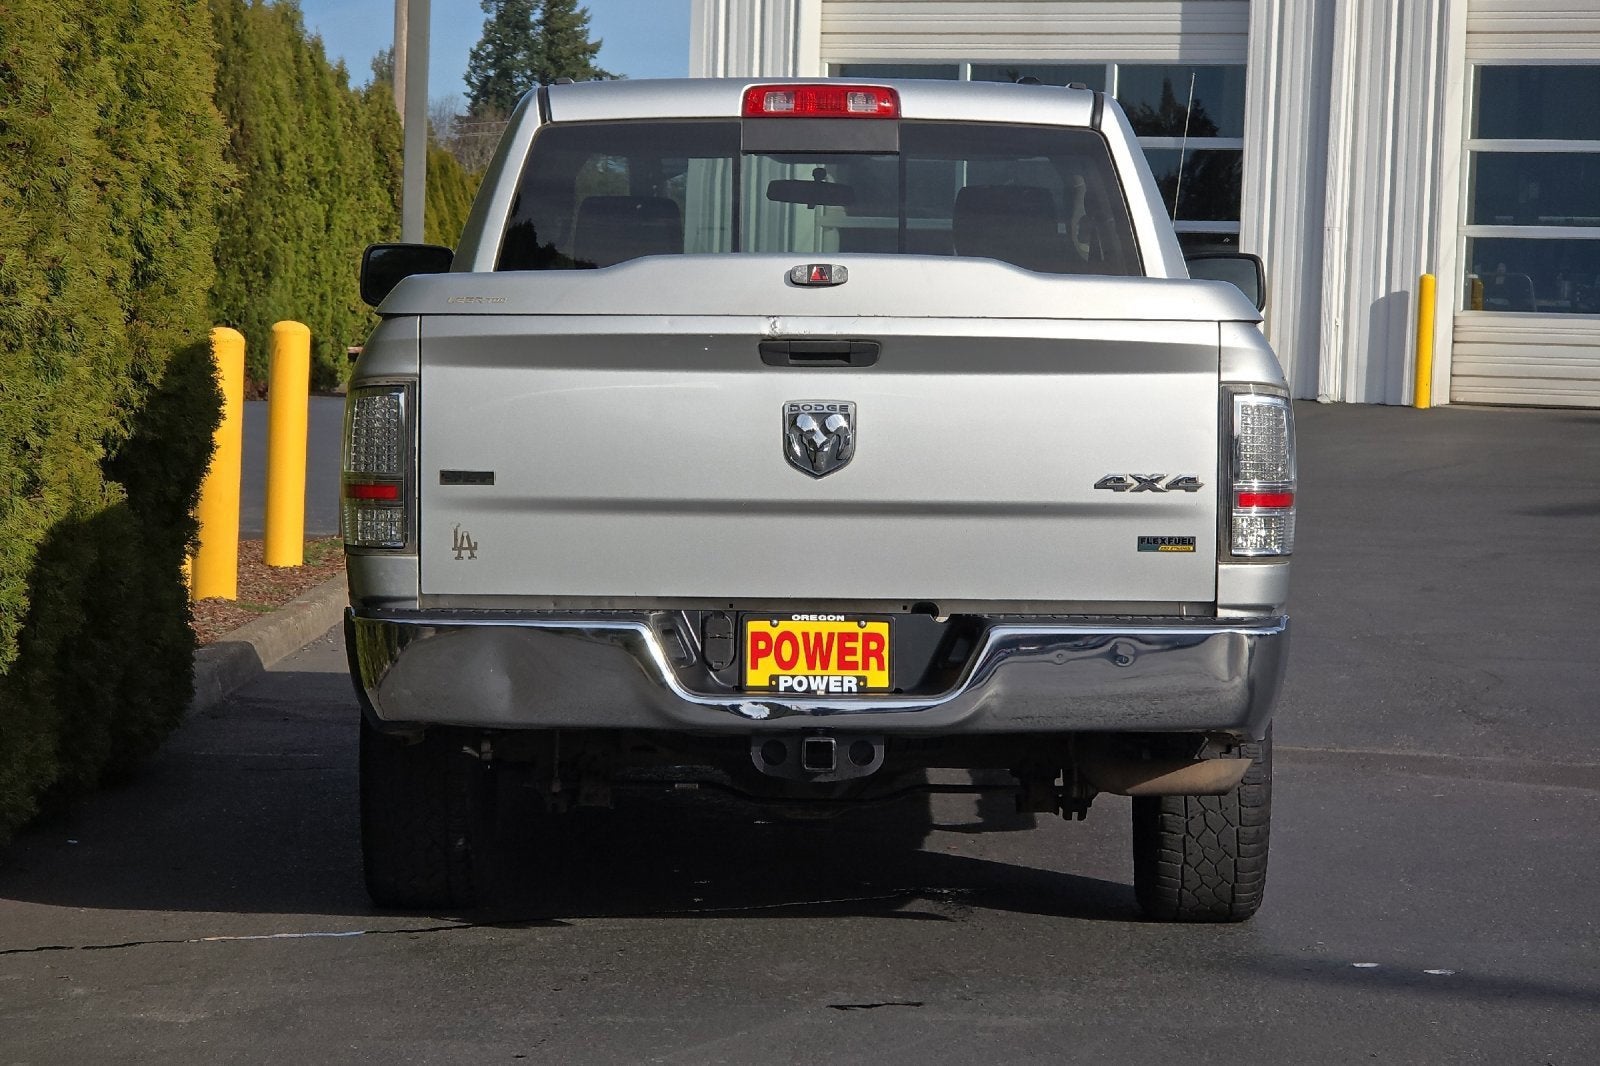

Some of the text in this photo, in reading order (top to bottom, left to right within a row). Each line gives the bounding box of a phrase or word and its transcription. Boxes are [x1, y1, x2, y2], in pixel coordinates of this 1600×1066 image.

[789, 404, 849, 412] DODGE
[451, 523, 478, 560] LA
[750, 631, 886, 671] POWER
[778, 676, 858, 693] POWER
